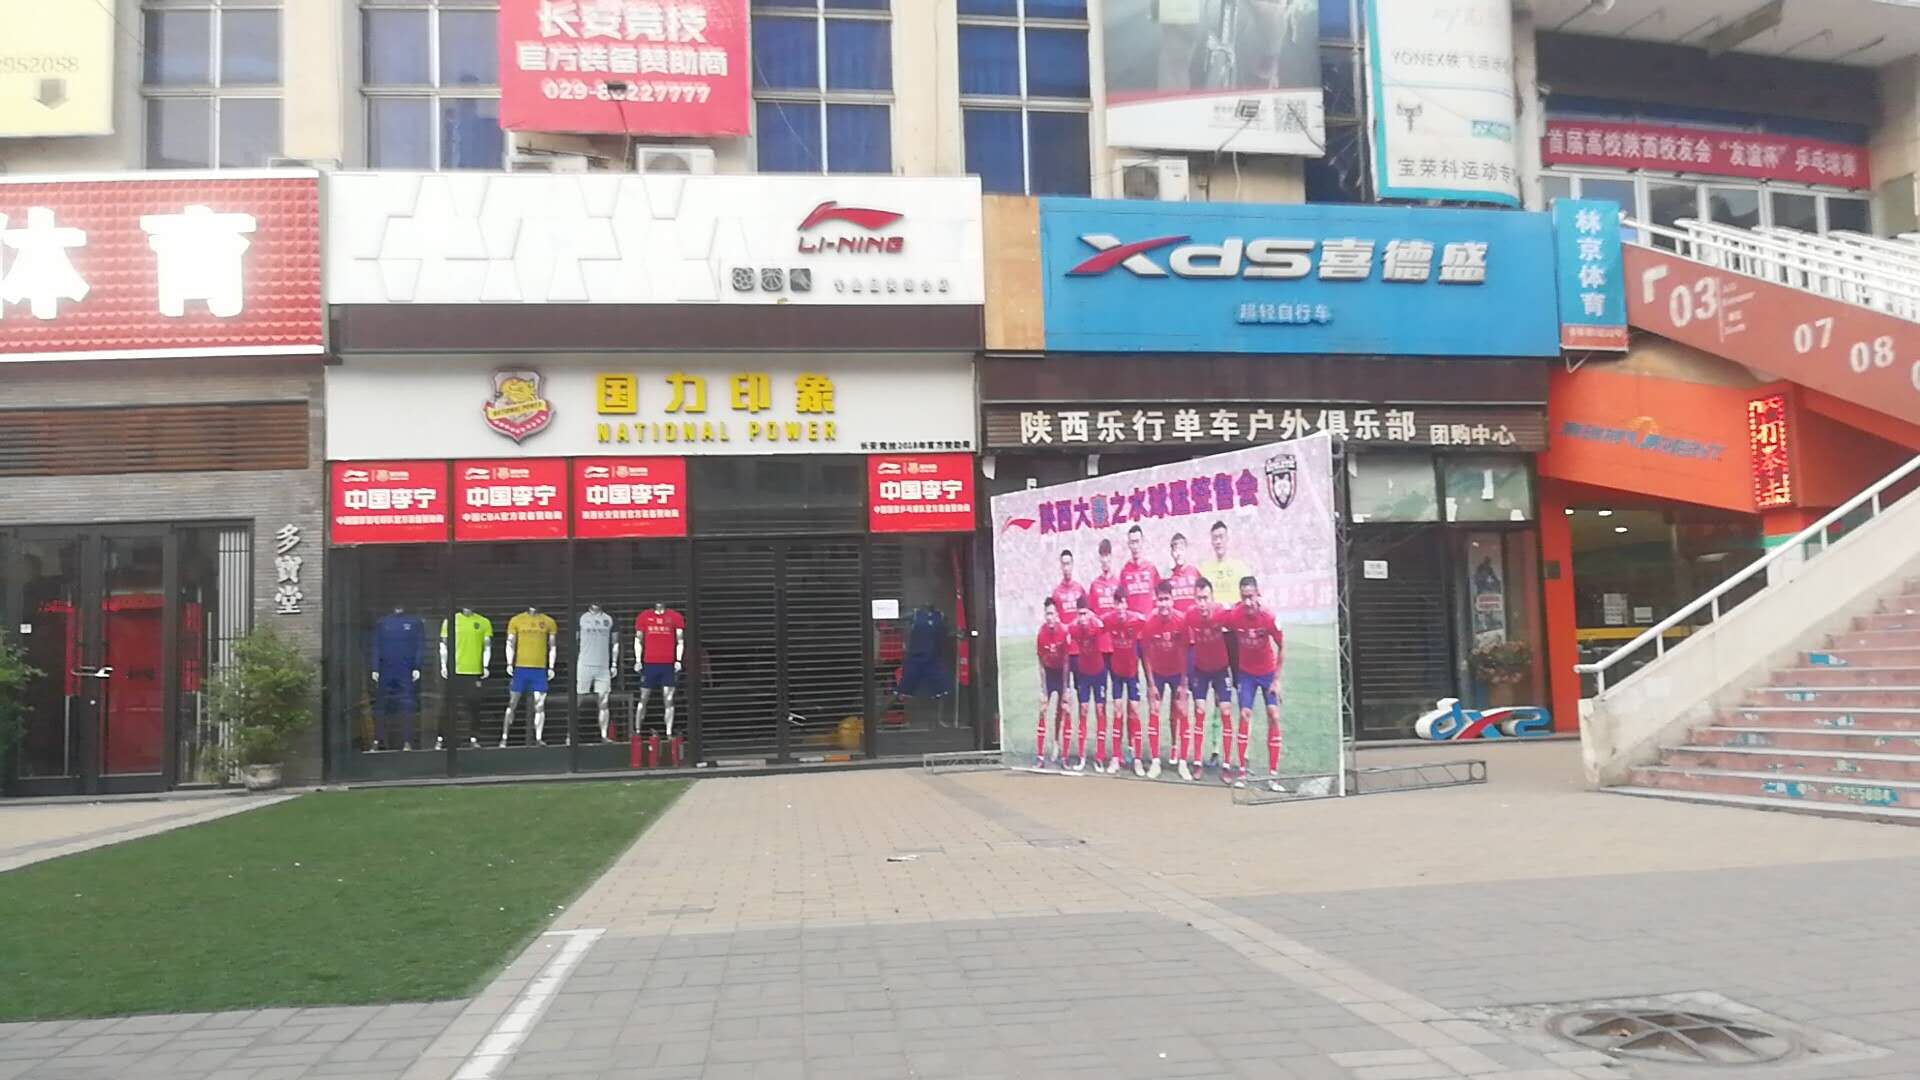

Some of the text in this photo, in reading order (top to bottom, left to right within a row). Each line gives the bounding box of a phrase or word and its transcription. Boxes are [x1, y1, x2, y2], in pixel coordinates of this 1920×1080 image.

[539, 0, 710, 43] 长安竞技
[516, 42, 729, 76] 官方装备赞助商
[0, 204, 257, 319] 体育
[797, 236, 905, 254] LI-NING
[1316, 238, 1489, 285] 喜德盛
[1575, 208, 1606, 317] 林京体育
[1237, 302, 1333, 324] 超轻自行车
[1668, 276, 1720, 328] 03
[1793, 317, 1834, 354] 07
[1850, 335, 1895, 373] 08
[597, 373, 836, 415] 国力印象
[597, 420, 837, 444] NATIONAL POWER
[1020, 409, 1516, 446] 陕西乐行单车户外俱乐部 团购中心
[344, 488, 437, 510] 中国李宁
[466, 485, 557, 508] 中国李宁
[586, 483, 675, 505] 中国李宁
[879, 480, 963, 501] 中国李宁
